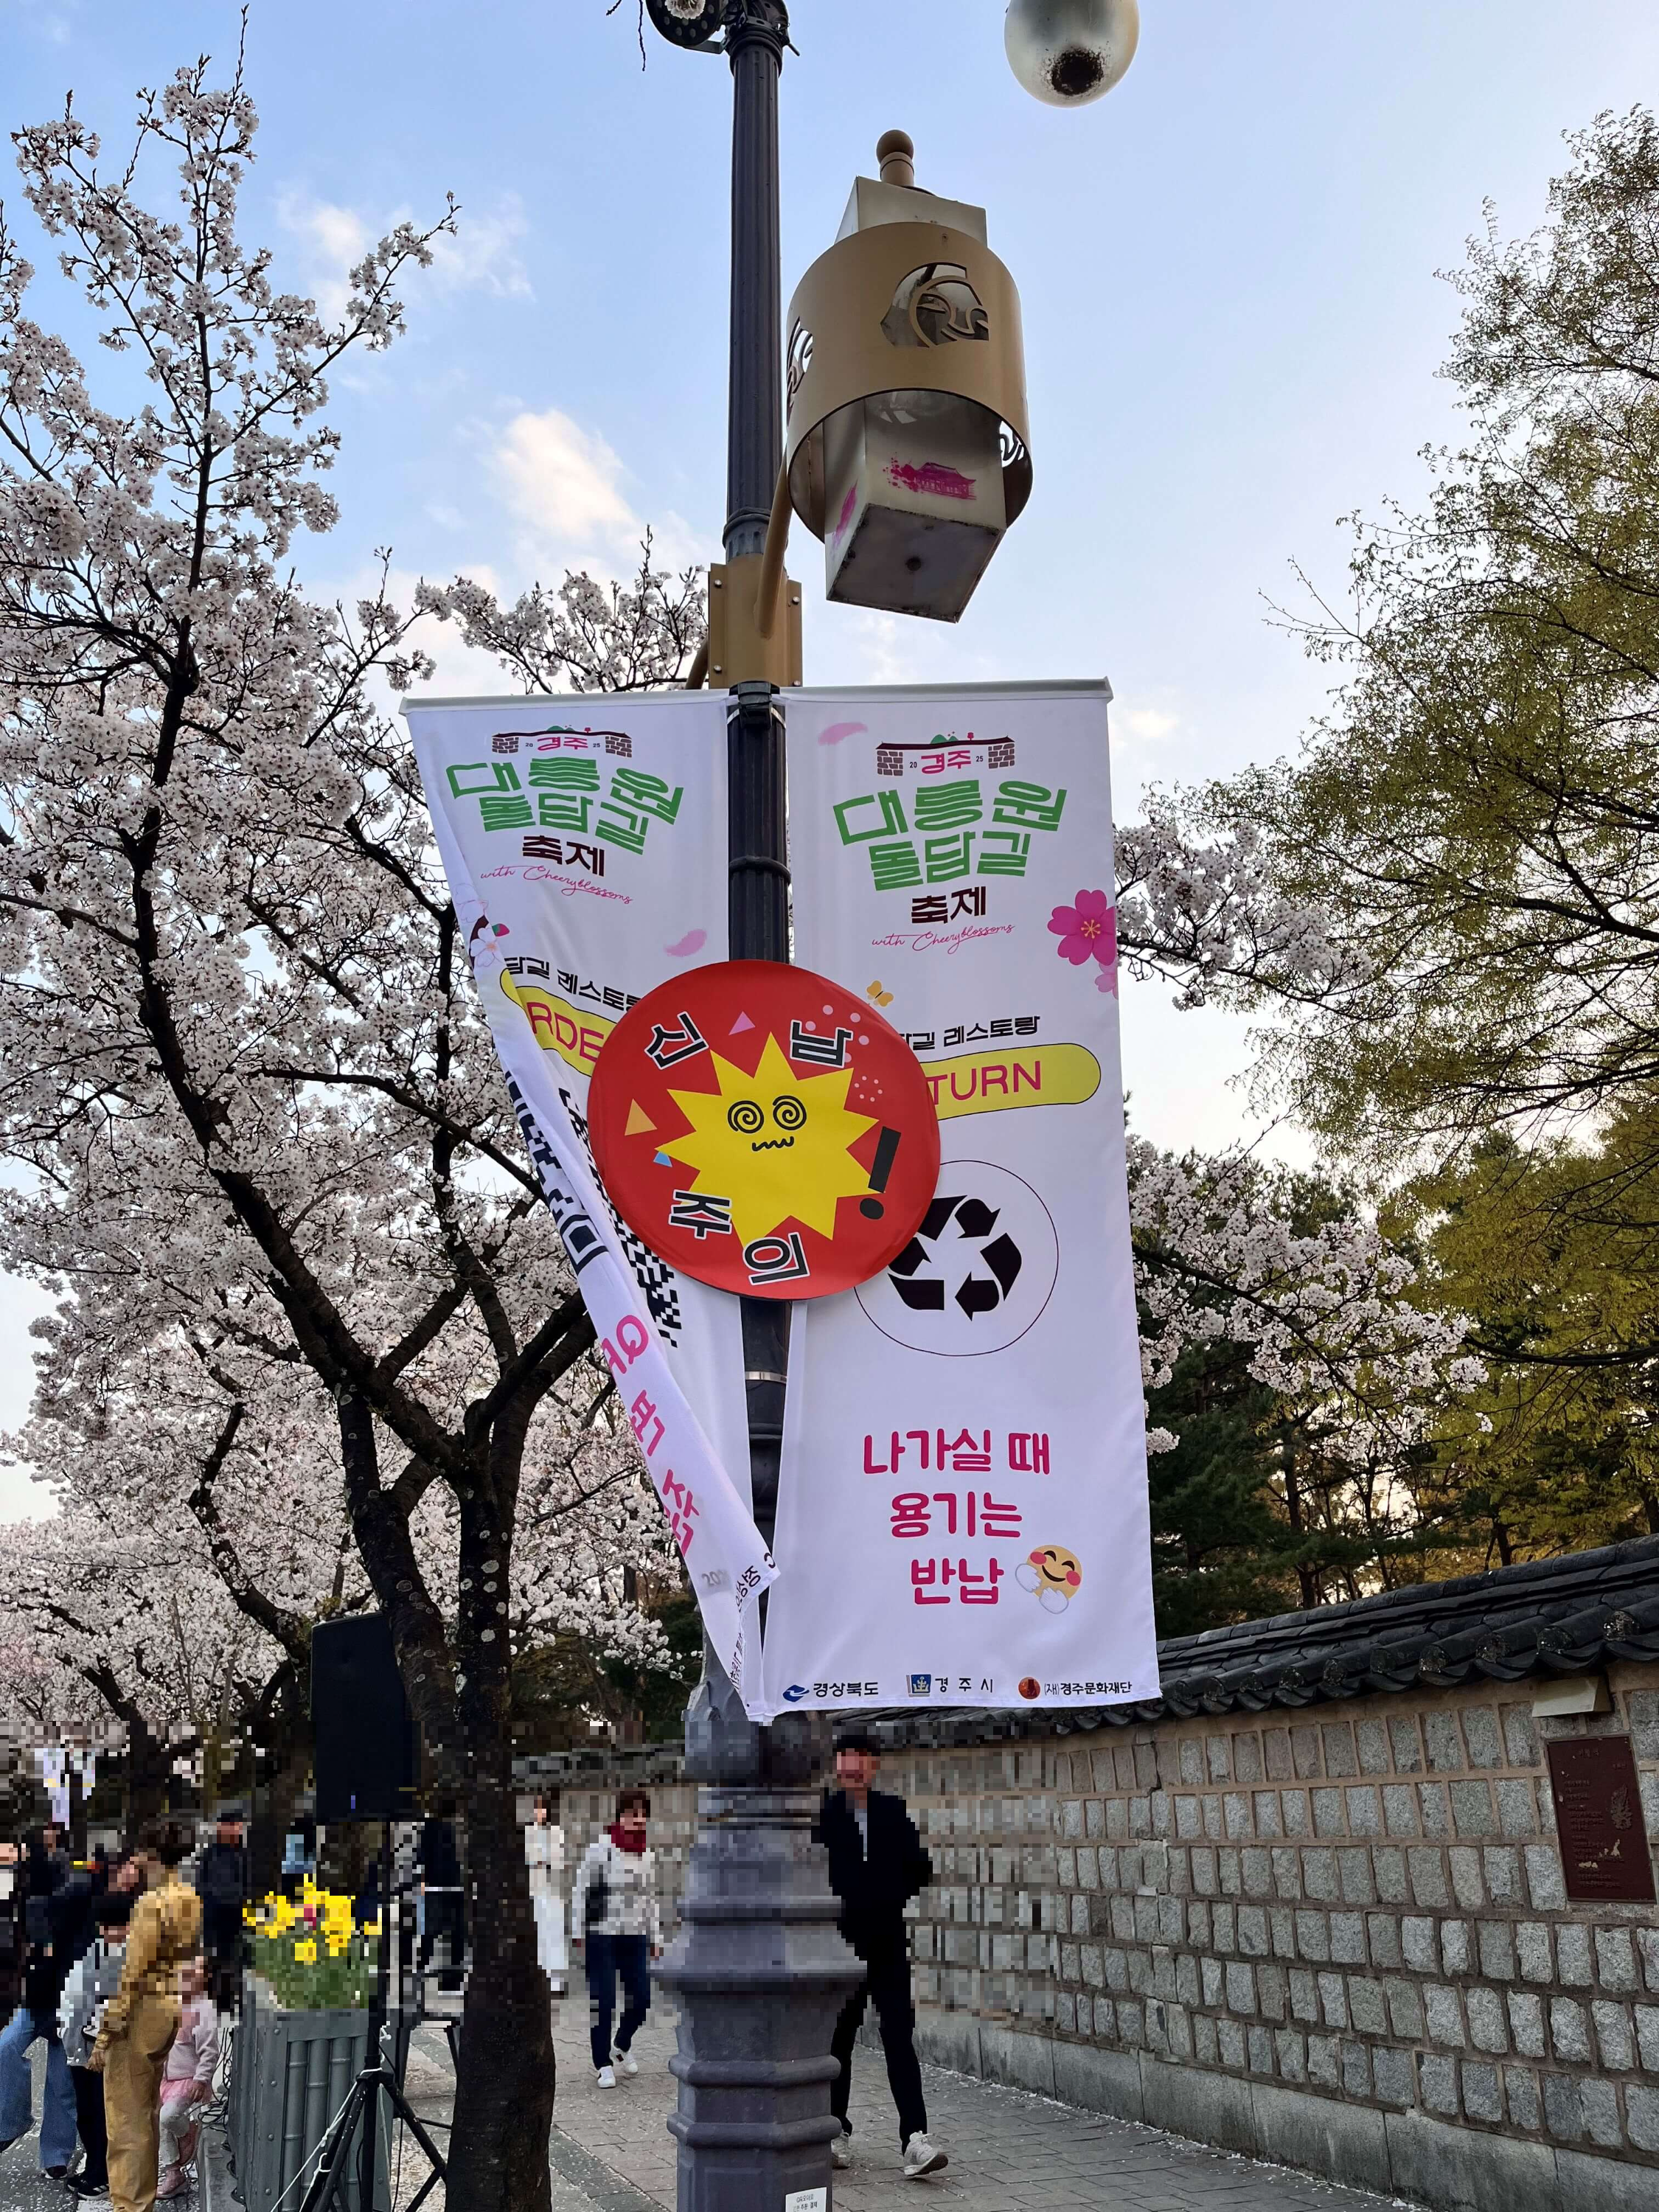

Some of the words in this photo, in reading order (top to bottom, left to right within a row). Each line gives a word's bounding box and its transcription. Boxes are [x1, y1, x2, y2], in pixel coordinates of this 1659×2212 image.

[537, 737, 588, 751] 경주
[921, 750, 971, 774] 경주
[445, 757, 684, 825] 대릉원
[833, 779, 1067, 846] 대릉원
[479, 793, 650, 855] 돌담길
[480, 865, 517, 879] with
[522, 835, 605, 877] 축제
[869, 831, 1031, 891] 돌담길
[911, 886, 987, 924] 축제
[872, 933, 905, 946] with
[944, 1015, 1040, 1047] 레스토랑
[926, 1060, 1041, 1105] TURN
[863, 1428, 992, 1475] 나가실
[1008, 1432, 1050, 1475] 때
[890, 1491, 1023, 1538] 용기는
[911, 1557, 1005, 1605] 반납
[813, 1681, 879, 1697] 경상북도
